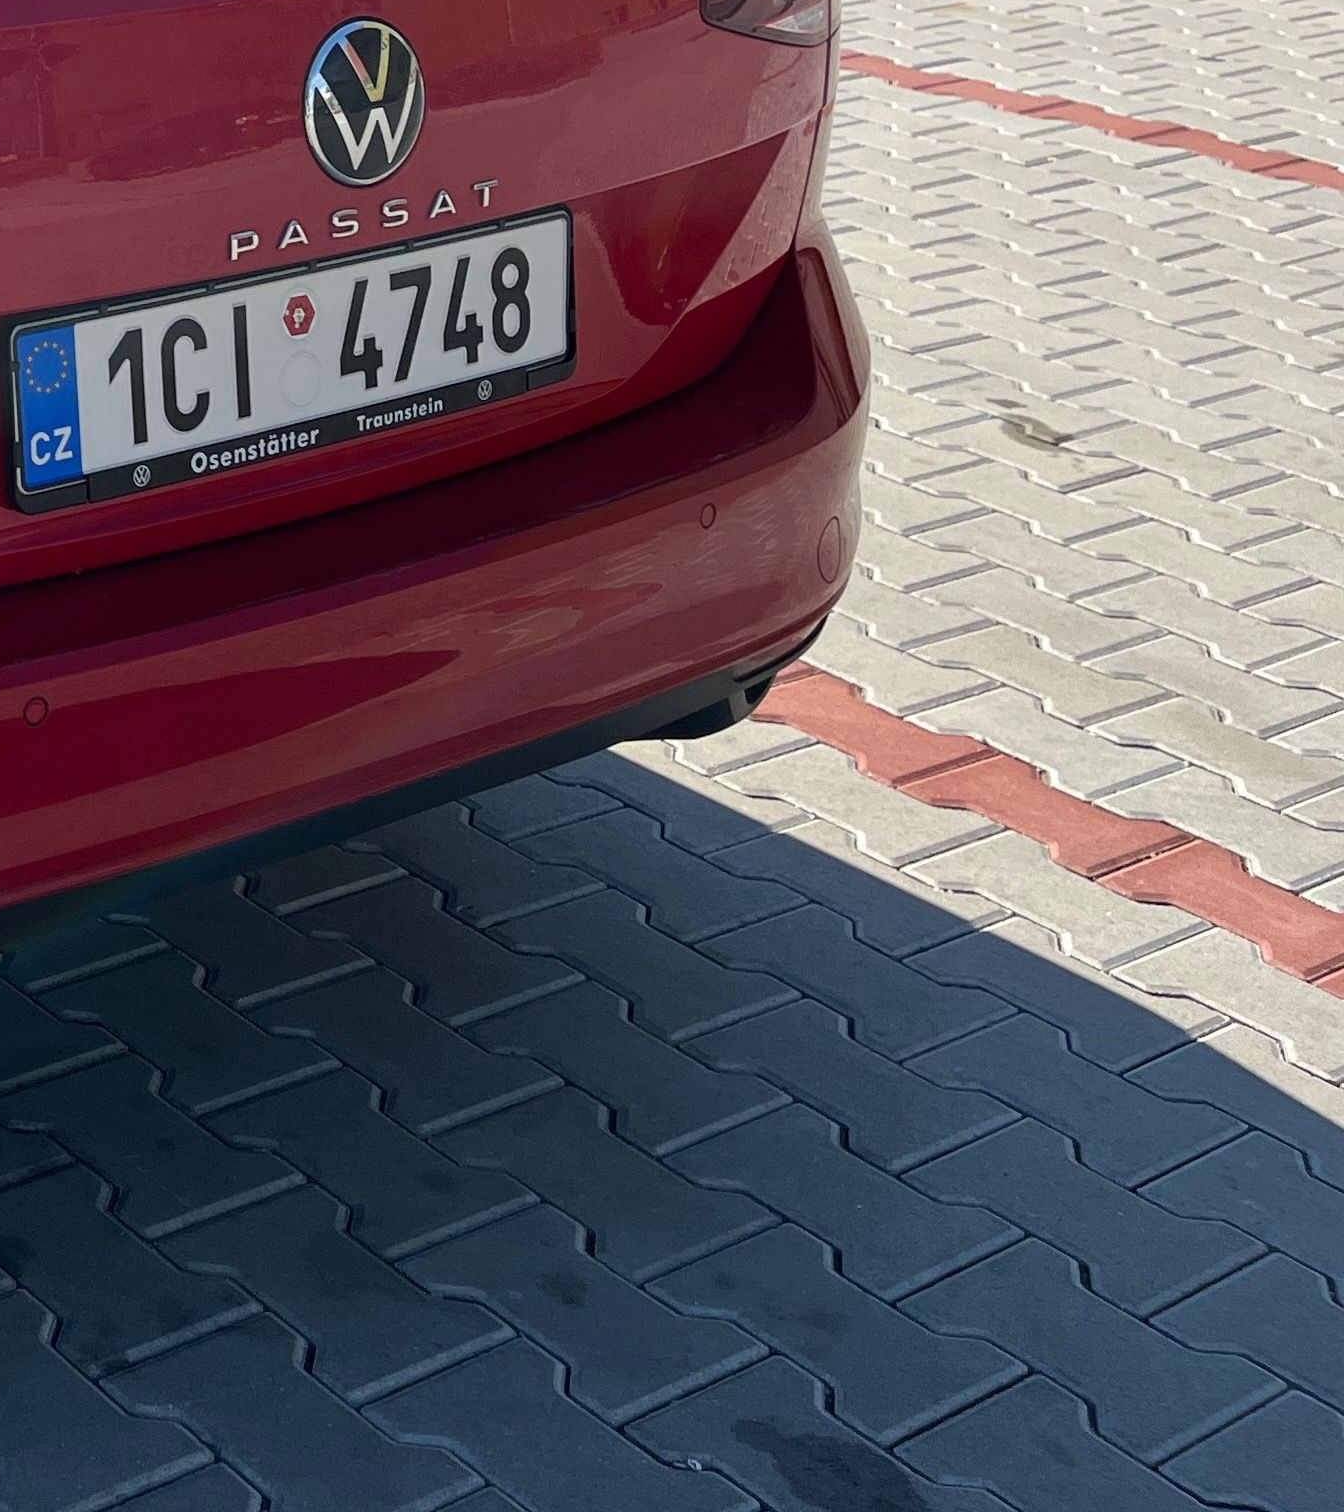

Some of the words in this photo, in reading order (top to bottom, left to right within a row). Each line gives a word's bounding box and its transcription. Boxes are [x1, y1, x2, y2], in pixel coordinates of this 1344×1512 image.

[229, 179, 500, 262] PASSAT
[339, 248, 531, 390] 4748
[30, 425, 74, 467] CZ
[190, 427, 320, 474] Osenstätter
[357, 397, 444, 432] Traunstein
